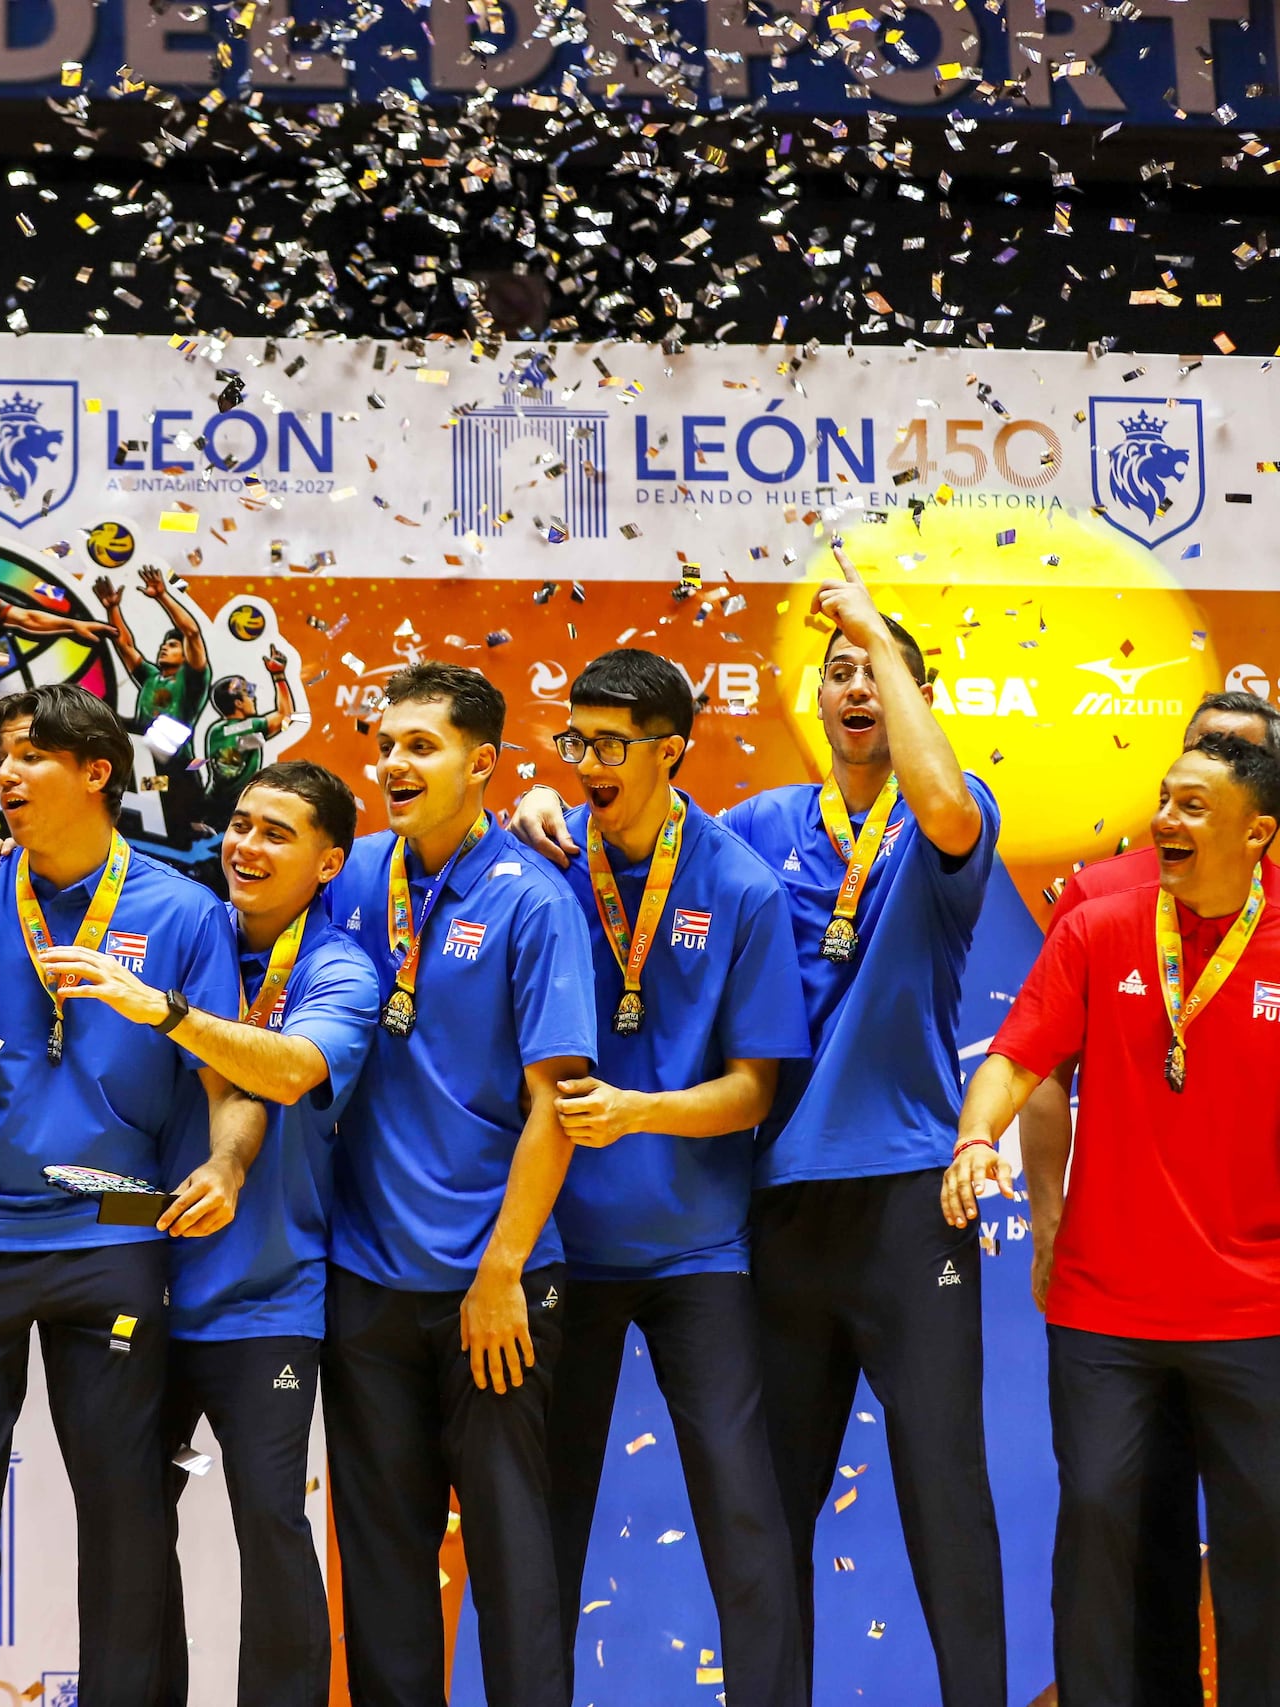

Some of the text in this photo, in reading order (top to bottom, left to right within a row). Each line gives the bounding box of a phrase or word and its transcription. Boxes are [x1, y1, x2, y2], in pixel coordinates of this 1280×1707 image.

[430, 0, 1280, 115] DEPORT
[636, 488, 753, 505] DEJANDO
[870, 491, 898, 507] EN
[952, 493, 1064, 509] HISTORIA
[669, 663, 760, 700] VB
[843, 863, 863, 898] LEÓN
[442, 941, 479, 961] PUR
[631, 933, 648, 968] LEÓN
[671, 932, 706, 950] PUR
[118, 957, 144, 974] UR
[1253, 1005, 1280, 1023] PU
[938, 1273, 961, 1287] PEAK
[273, 1379, 300, 1390] PEAK
